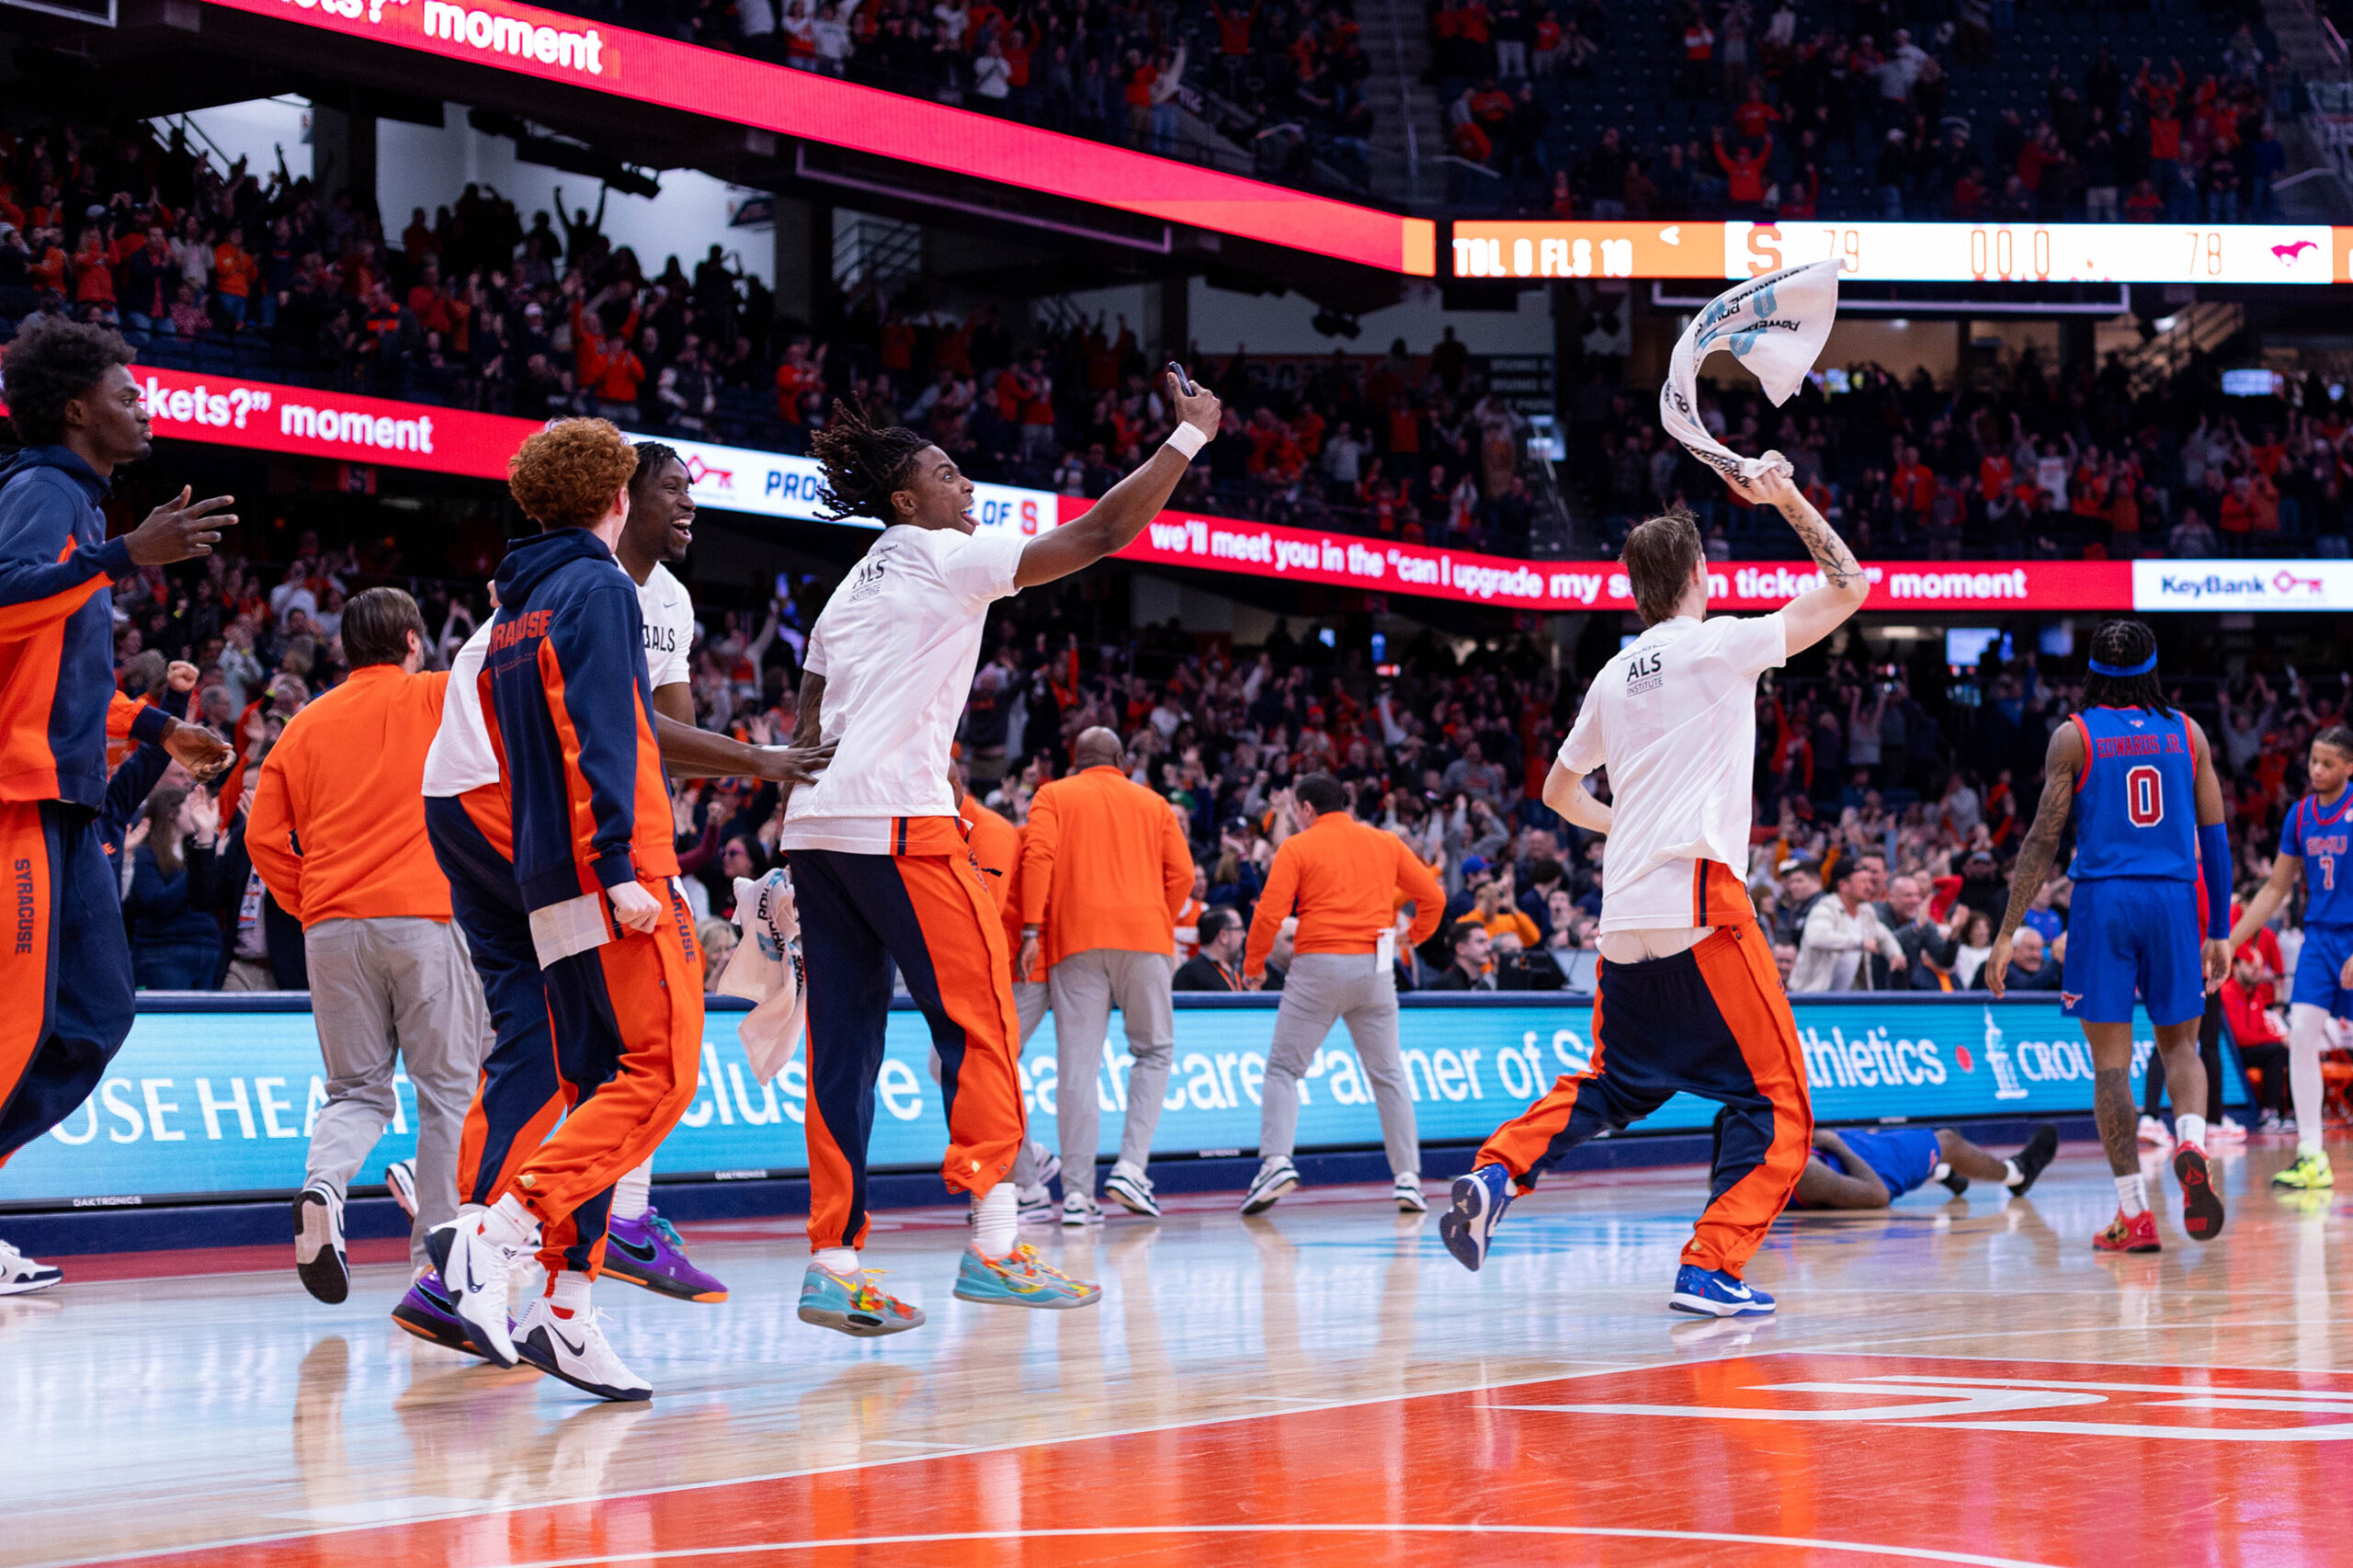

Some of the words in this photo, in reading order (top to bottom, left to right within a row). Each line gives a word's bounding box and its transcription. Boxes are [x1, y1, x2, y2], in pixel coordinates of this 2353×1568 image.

[424, 1, 603, 74] moment
[1824, 230, 1859, 273] 79
[2186, 233, 2222, 275] 78
[281, 403, 434, 453] moment
[765, 471, 824, 502] PRO
[981, 500, 1011, 525] OF
[852, 558, 888, 589] ALS
[1211, 530, 1272, 563] meet
[1274, 539, 1318, 572] you
[1322, 539, 1345, 573] in
[1347, 543, 1385, 578] the
[1440, 553, 1452, 586] I
[1452, 565, 1544, 599] upgrade
[1549, 573, 1602, 605] my
[1890, 569, 2029, 598] moment
[2162, 575, 2266, 599] KeyBank
[1627, 652, 1662, 682] ALS
[1627, 676, 1664, 696] INSTITUTE
[2097, 734, 2160, 758] EDWARDS
[2165, 733, 2184, 754] JR.
[2126, 765, 2164, 828] 0
[2306, 835, 2347, 856] SMU
[2319, 856, 2335, 890] 7
[15, 858, 34, 955] SYRACUSE
[1496, 1030, 1549, 1099] of
[1797, 1025, 1947, 1088] thletics
[2017, 1040, 2097, 1082] CROU
[73, 1196, 142, 1207] DAKTRONICS
